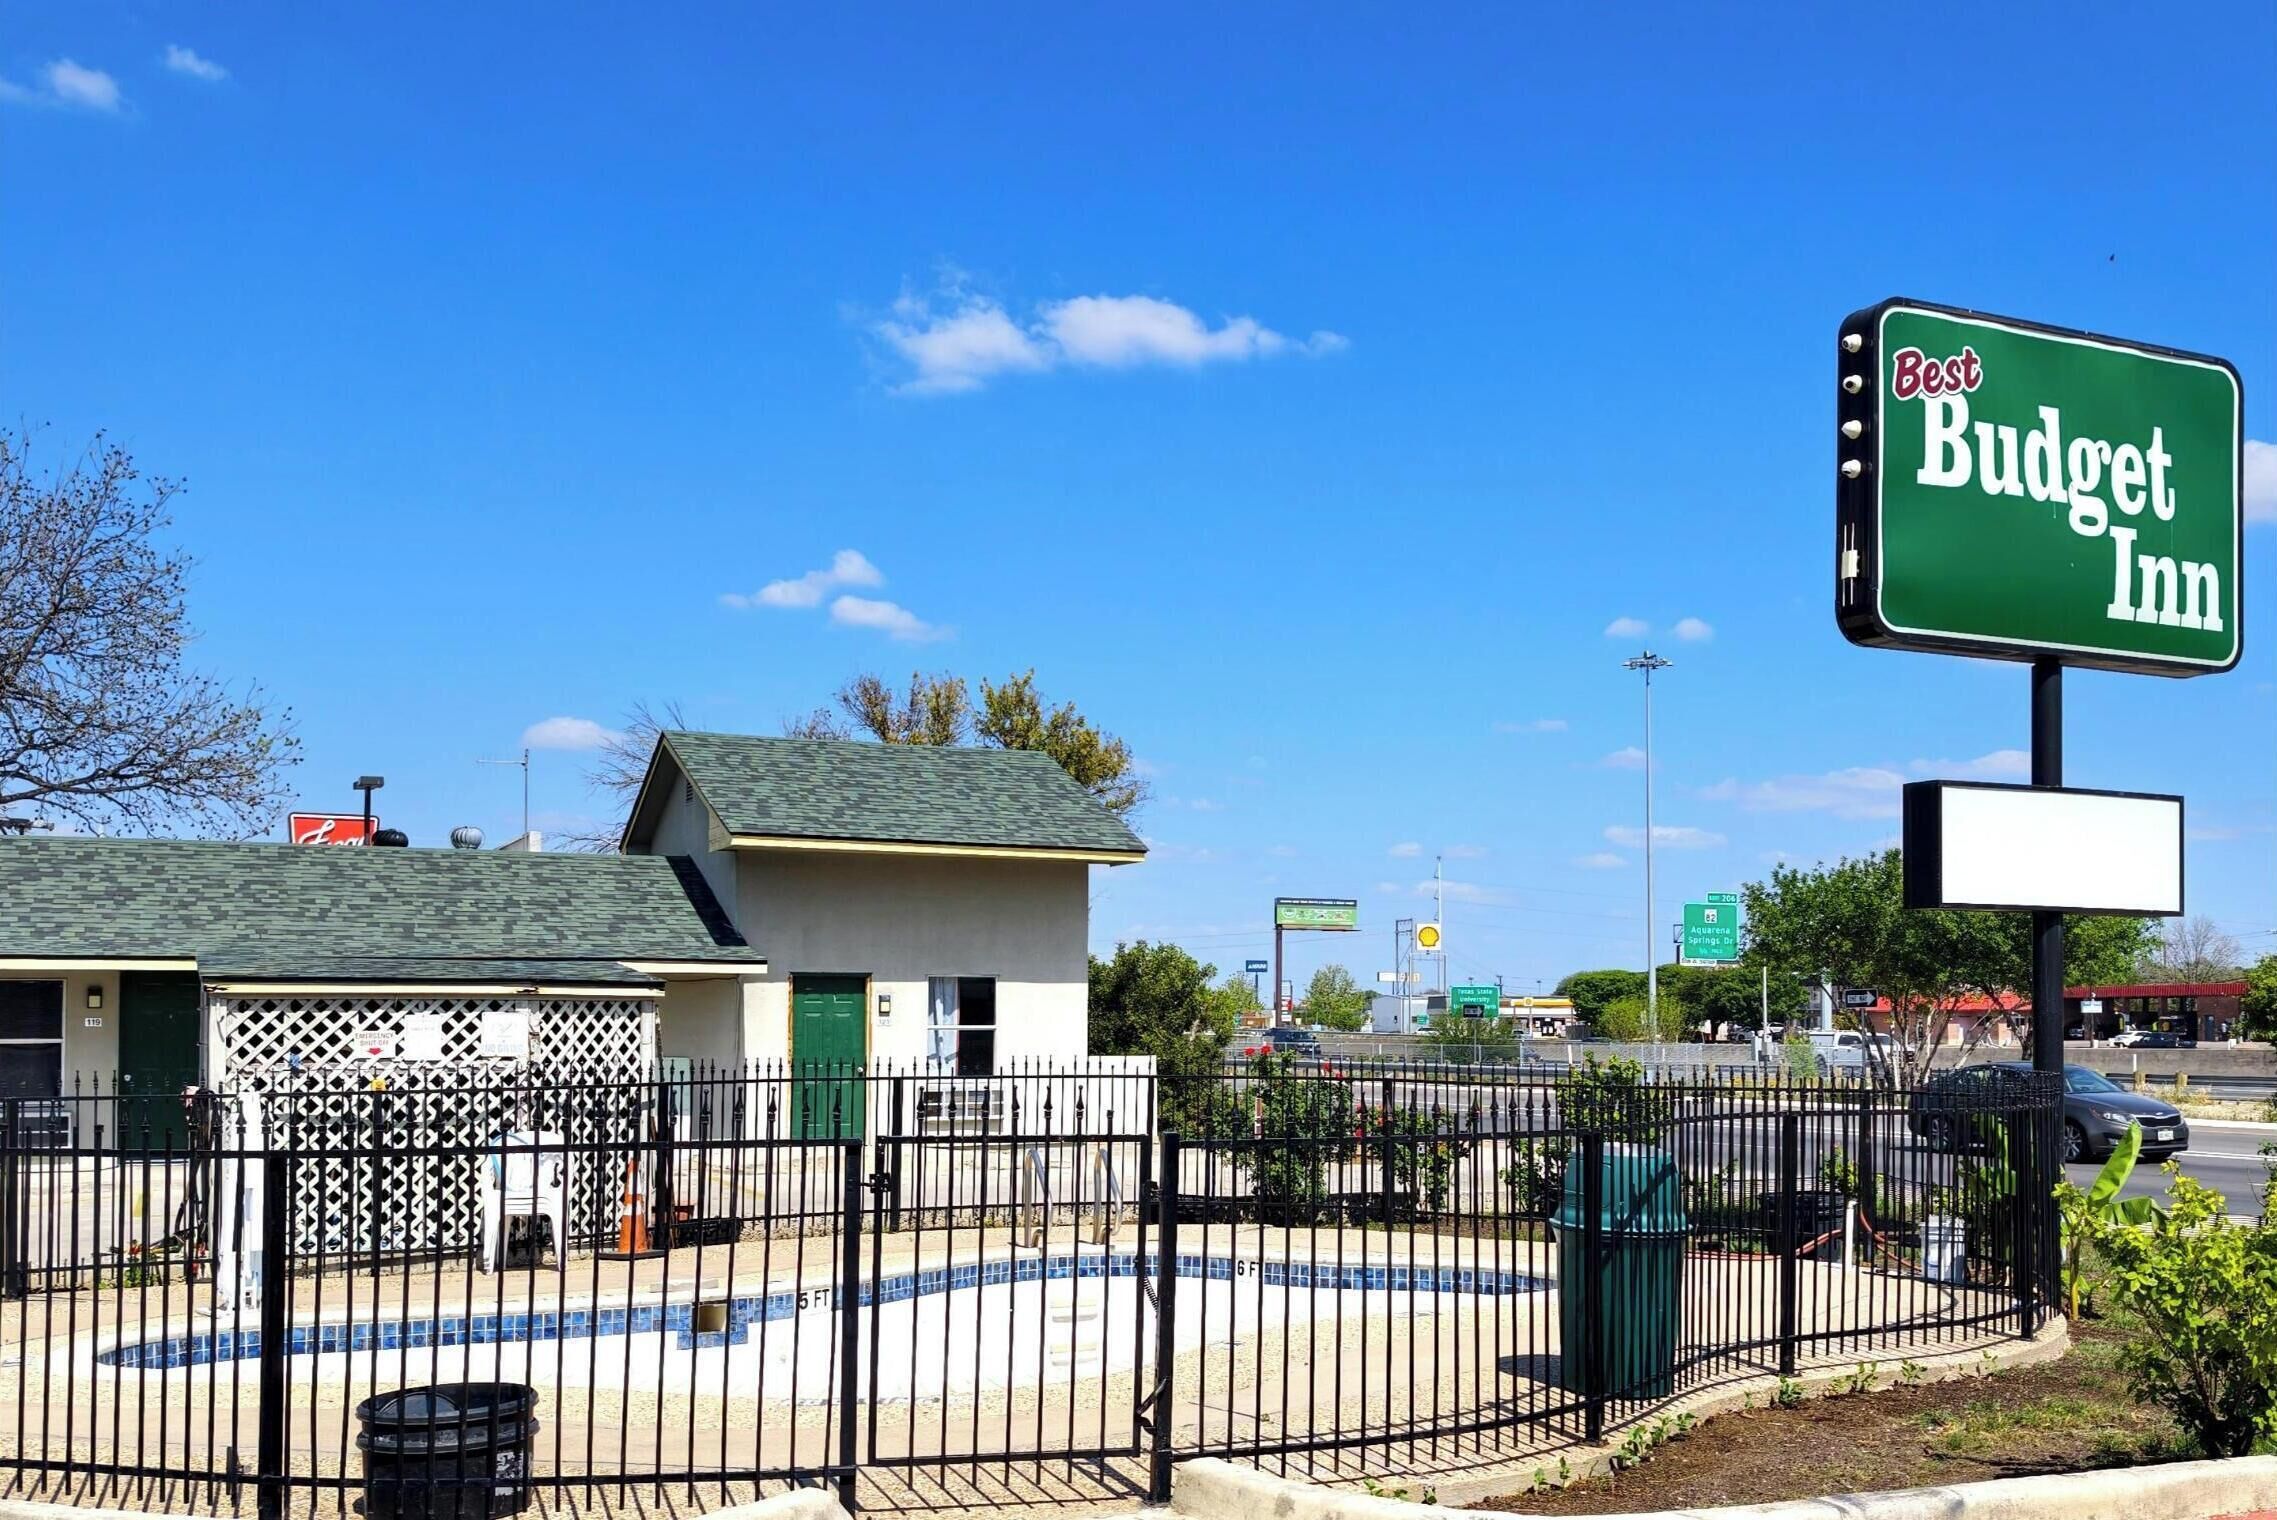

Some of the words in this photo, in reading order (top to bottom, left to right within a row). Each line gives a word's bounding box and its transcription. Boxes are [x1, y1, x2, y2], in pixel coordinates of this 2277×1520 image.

[1893, 345, 1983, 401] Best
[1917, 393, 2176, 537] Budget
[2106, 526, 2223, 632] Inn
[1691, 926, 1731, 936] Aquarena
[1688, 936, 1720, 946] Springs
[1460, 996, 1489, 1004] University
[355, 1032, 394, 1040] EMERGENCY
[1237, 1260, 1244, 1276] 6
[799, 1292, 808, 1309] 5
[814, 1288, 830, 1308] FT
